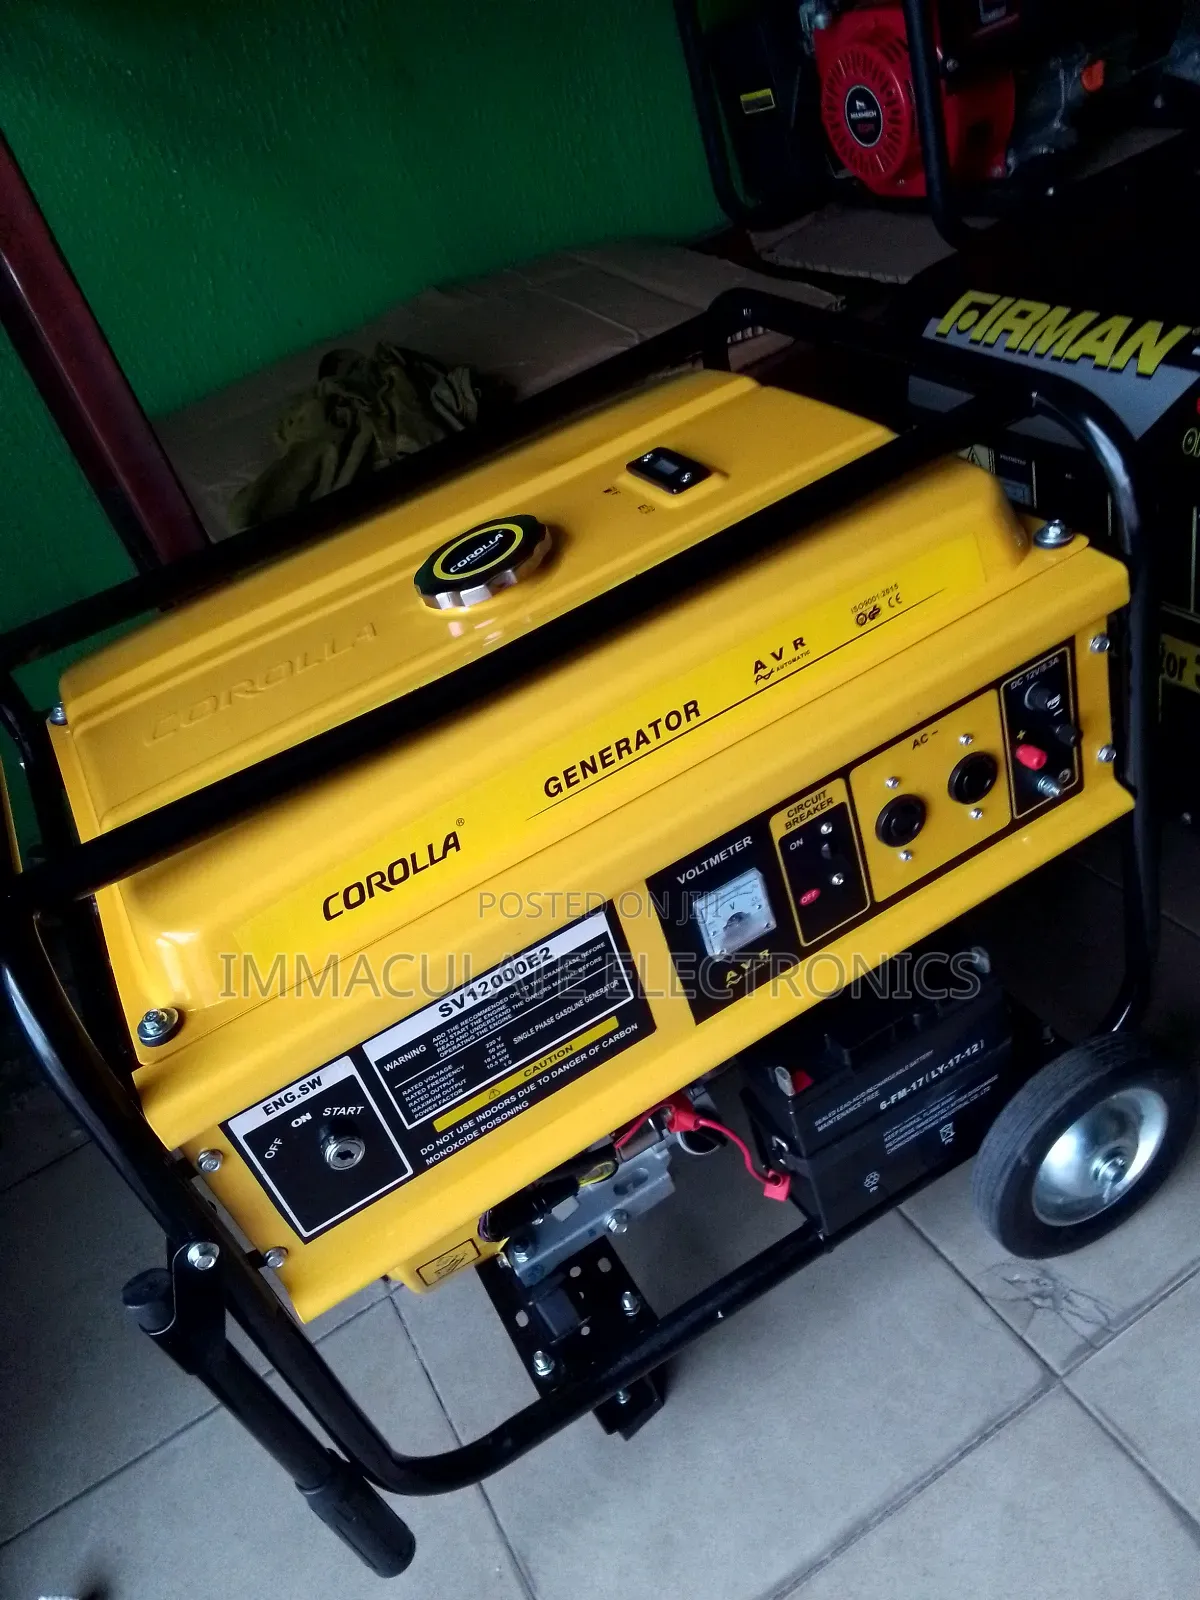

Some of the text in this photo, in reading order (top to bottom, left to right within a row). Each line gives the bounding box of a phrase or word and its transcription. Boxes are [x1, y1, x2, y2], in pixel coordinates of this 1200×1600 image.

[935, 289, 1193, 378] FIRMAN
[449, 533, 504, 573] COROLLA
[776, 650, 811, 672] AUTOMATIC
[543, 700, 701, 798] GENERATOR
[784, 797, 834, 831] BREAKER
[787, 790, 827, 818] CIRCUIT
[676, 836, 753, 885] VOLTMETER
[789, 838, 804, 851] ON
[322, 831, 461, 921] COROLLA
[801, 890, 817, 904] OFF
[432, 1032, 446, 1043] ADD
[447, 1024, 460, 1034] THE
[460, 997, 509, 1026] RECOMMENDED
[530, 978, 543, 987] THE
[581, 941, 606, 958] BEFORE
[438, 946, 555, 1018] SV12000E2
[437, 1040, 455, 1053] READ
[455, 1032, 469, 1043] AND
[469, 1008, 511, 1034] UNDERSTAND
[512, 1000, 525, 1010] THE
[552, 970, 579, 987] MANUAL
[578, 955, 603, 973] BEFORE
[512, 979, 620, 1045] SINGLE PHASE GASOLINE GENERATOR
[434, 1037, 448, 1048] YOU
[449, 1025, 469, 1040] START
[470, 1018, 482, 1028] THE
[439, 1035, 475, 1058] OPERATING
[476, 1027, 489, 1037] THE
[485, 1039, 497, 1049] 220
[383, 1044, 427, 1072] WARNING
[496, 1048, 507, 1057] KW
[499, 1053, 510, 1062] KW
[523, 1044, 574, 1077] CAUTION
[262, 1075, 323, 1117] ENG.SW
[402, 1064, 453, 1096] RATED VOLTAGE
[405, 1064, 465, 1102] RATED FREQUENCY
[408, 1077, 455, 1108] RATED OUTPUT
[411, 1078, 467, 1114] MAXIMUM OUTPUT
[420, 1022, 639, 1155] DO NOT USE INDOORS DUE TO DANGER OF CARBON
[322, 1106, 364, 1116] START
[414, 1088, 464, 1119] POWER FACTOR
[291, 1112, 312, 1128] ON
[425, 1100, 529, 1165] MONOXCIDE POISONING
[264, 1137, 284, 1159] OFF
